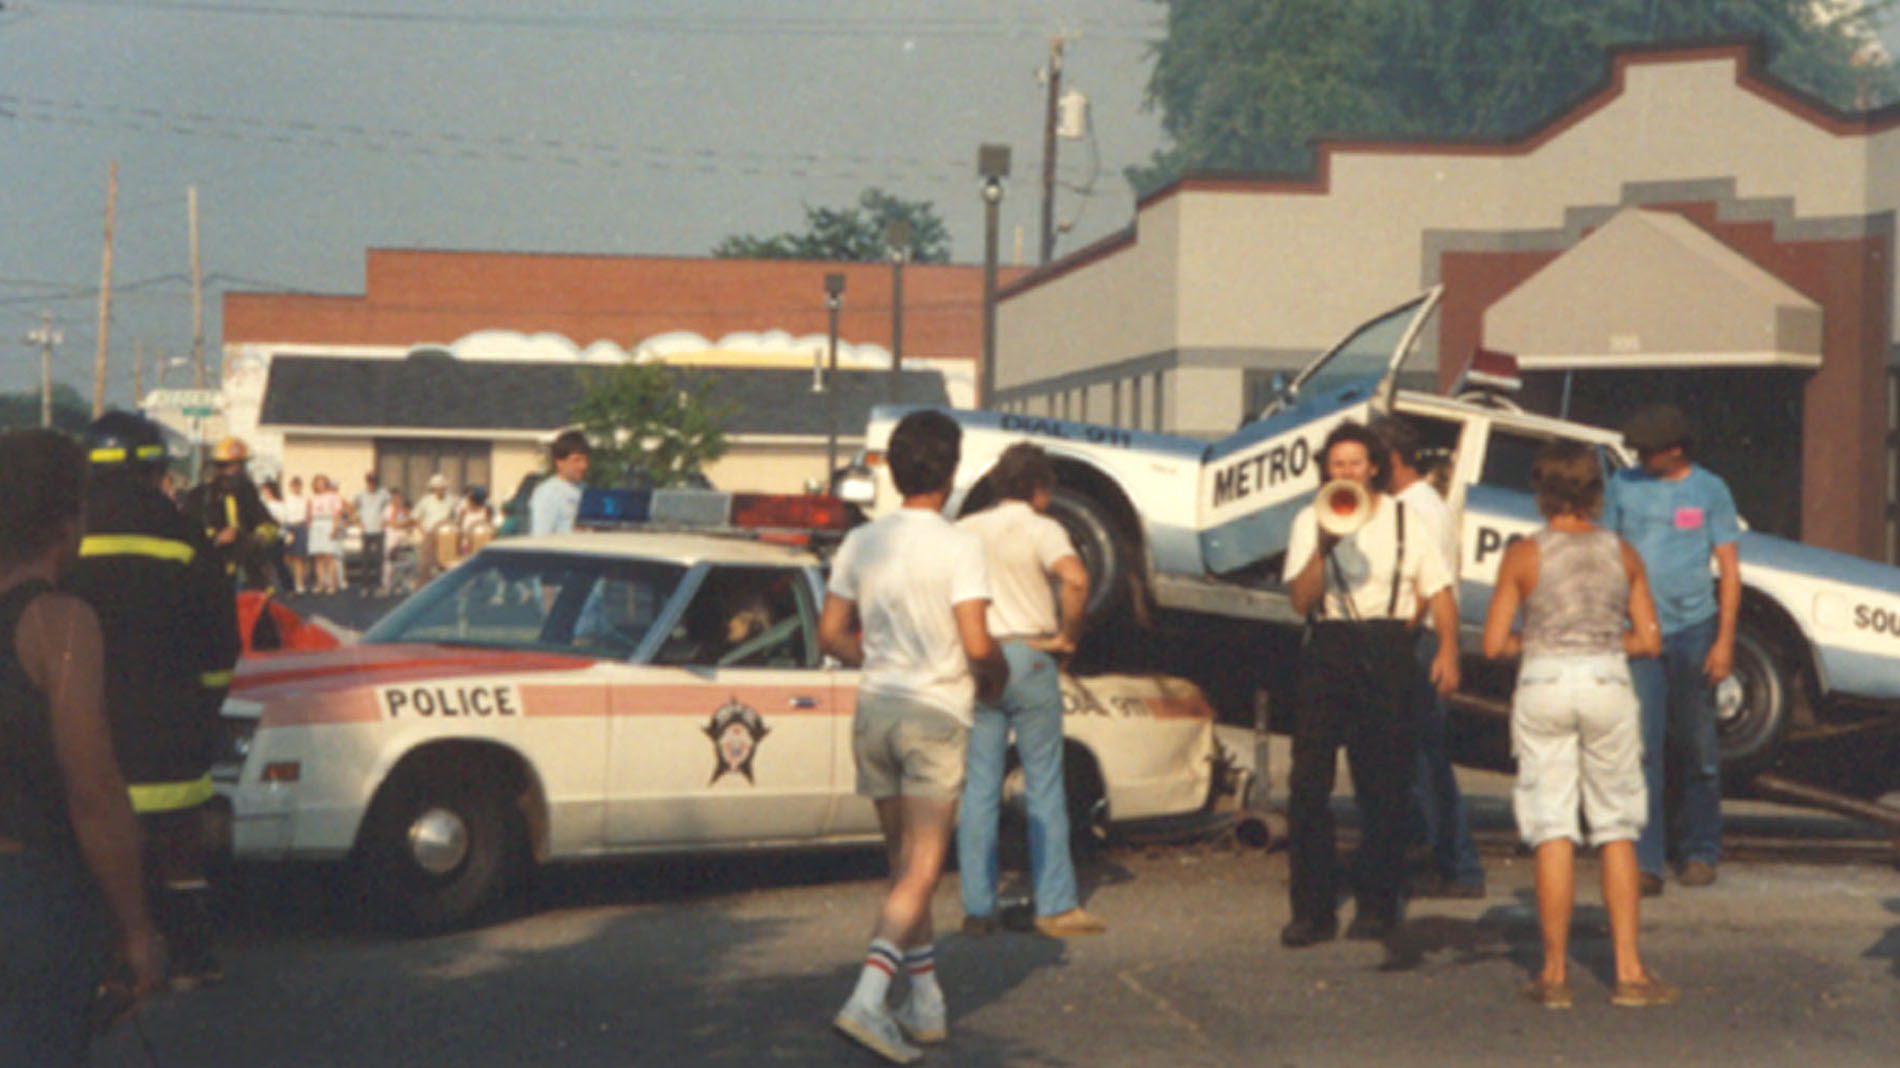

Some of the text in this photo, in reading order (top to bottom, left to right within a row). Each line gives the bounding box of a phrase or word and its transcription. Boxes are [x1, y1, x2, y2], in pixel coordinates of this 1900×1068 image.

[1001, 414, 1131, 448] DIAL 911
[1213, 436, 1308, 508] METRO
[385, 686, 516, 717] POLICE
